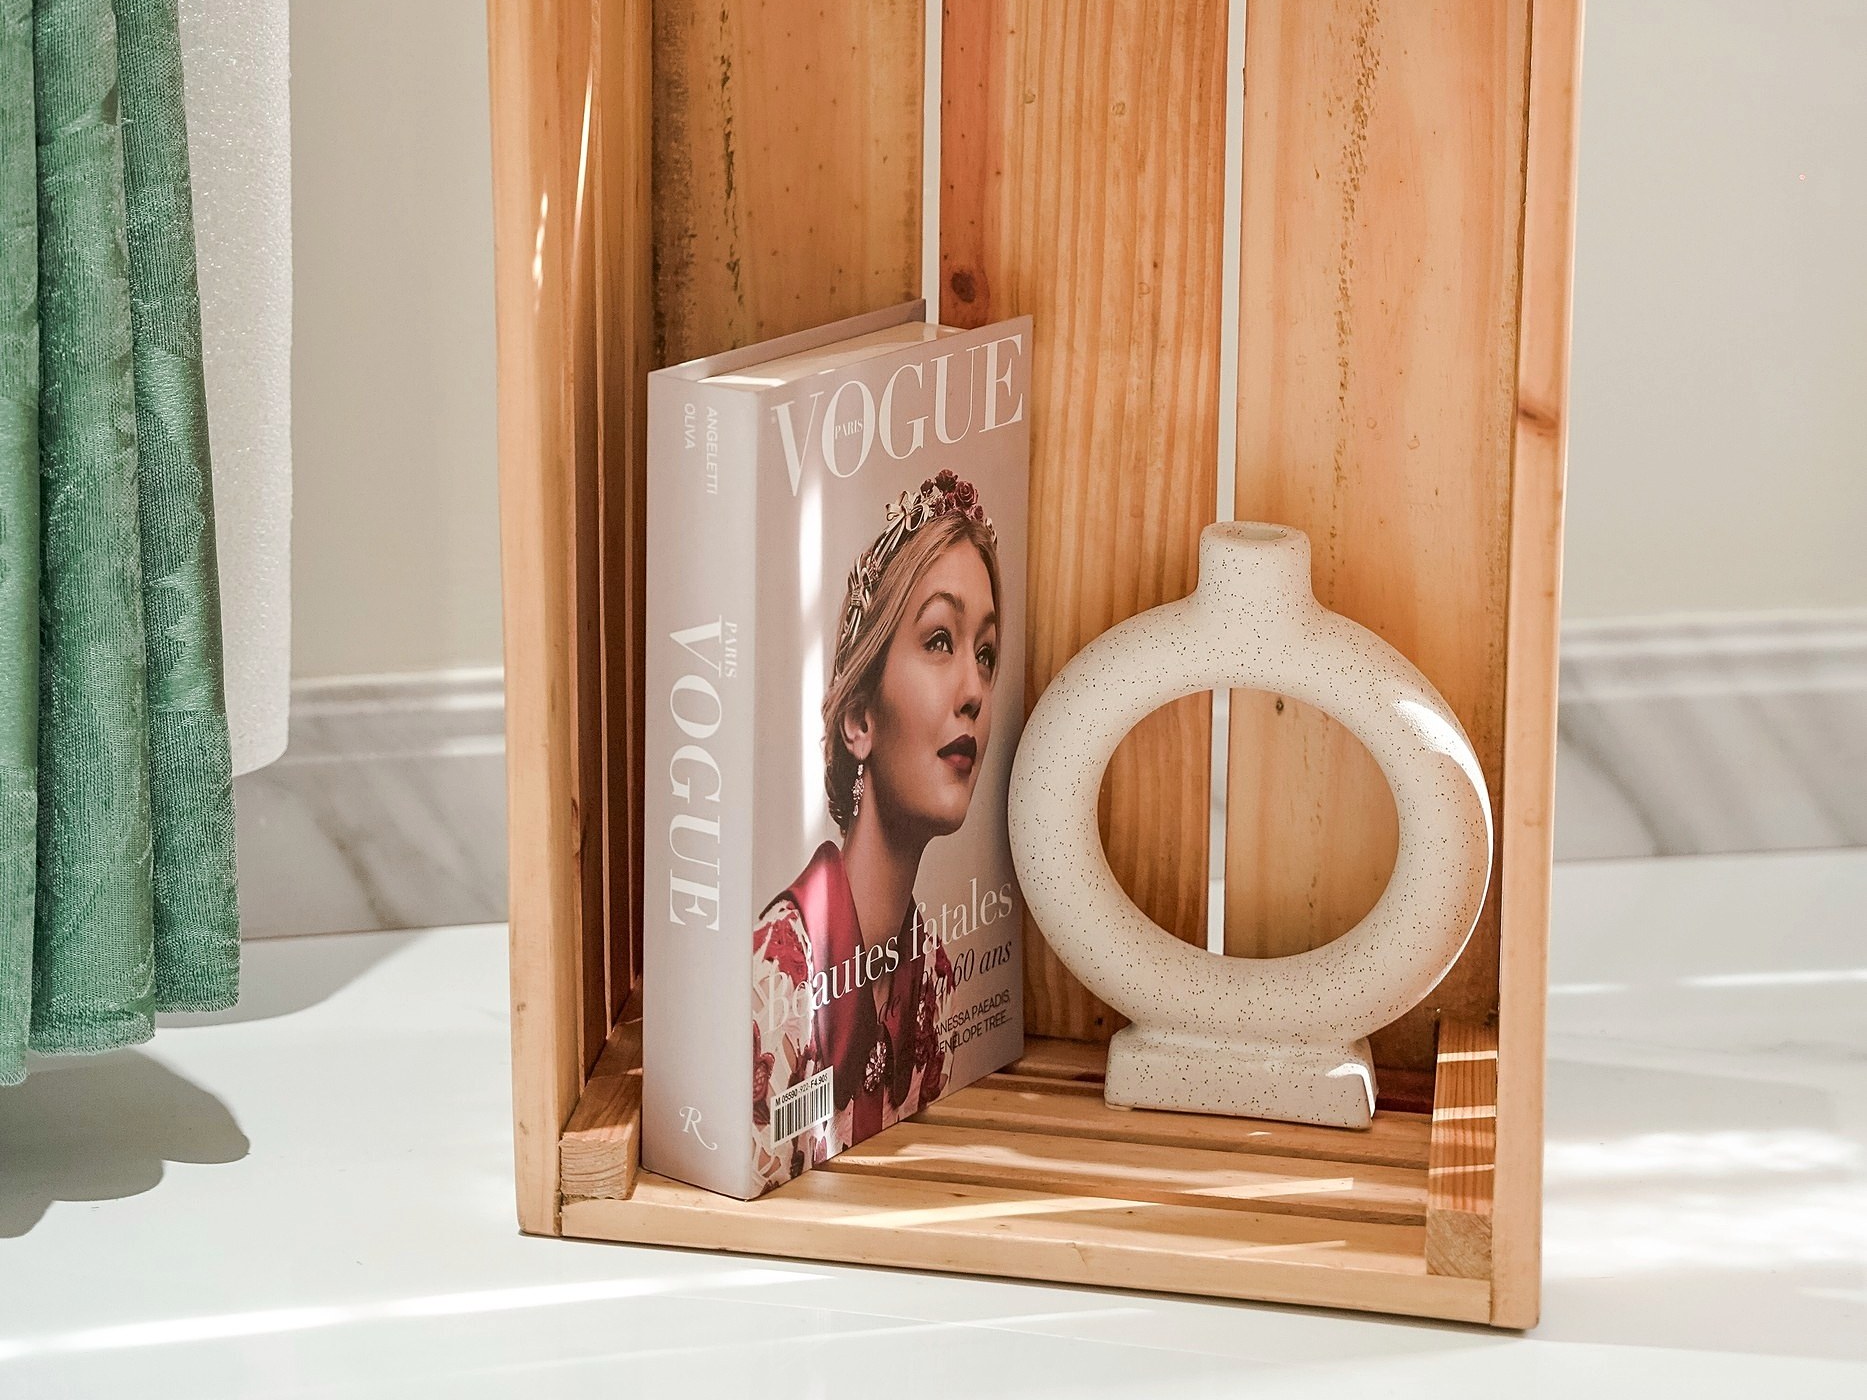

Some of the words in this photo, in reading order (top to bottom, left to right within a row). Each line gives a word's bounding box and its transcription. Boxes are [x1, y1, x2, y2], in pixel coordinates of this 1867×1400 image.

[683, 402, 697, 450] OLIVA
[770, 333, 1024, 498] VOGUE
[834, 417, 864, 440] PARIS
[705, 405, 719, 496] ANGELETTI
[724, 620, 739, 680] PARIS
[668, 614, 723, 932] VOGUE
[909, 876, 1013, 962] fatales
[952, 947, 975, 988] 60
[979, 940, 1012, 975] ans
[933, 1008, 971, 1037] ANESSA
[678, 1105, 718, 1151] R
